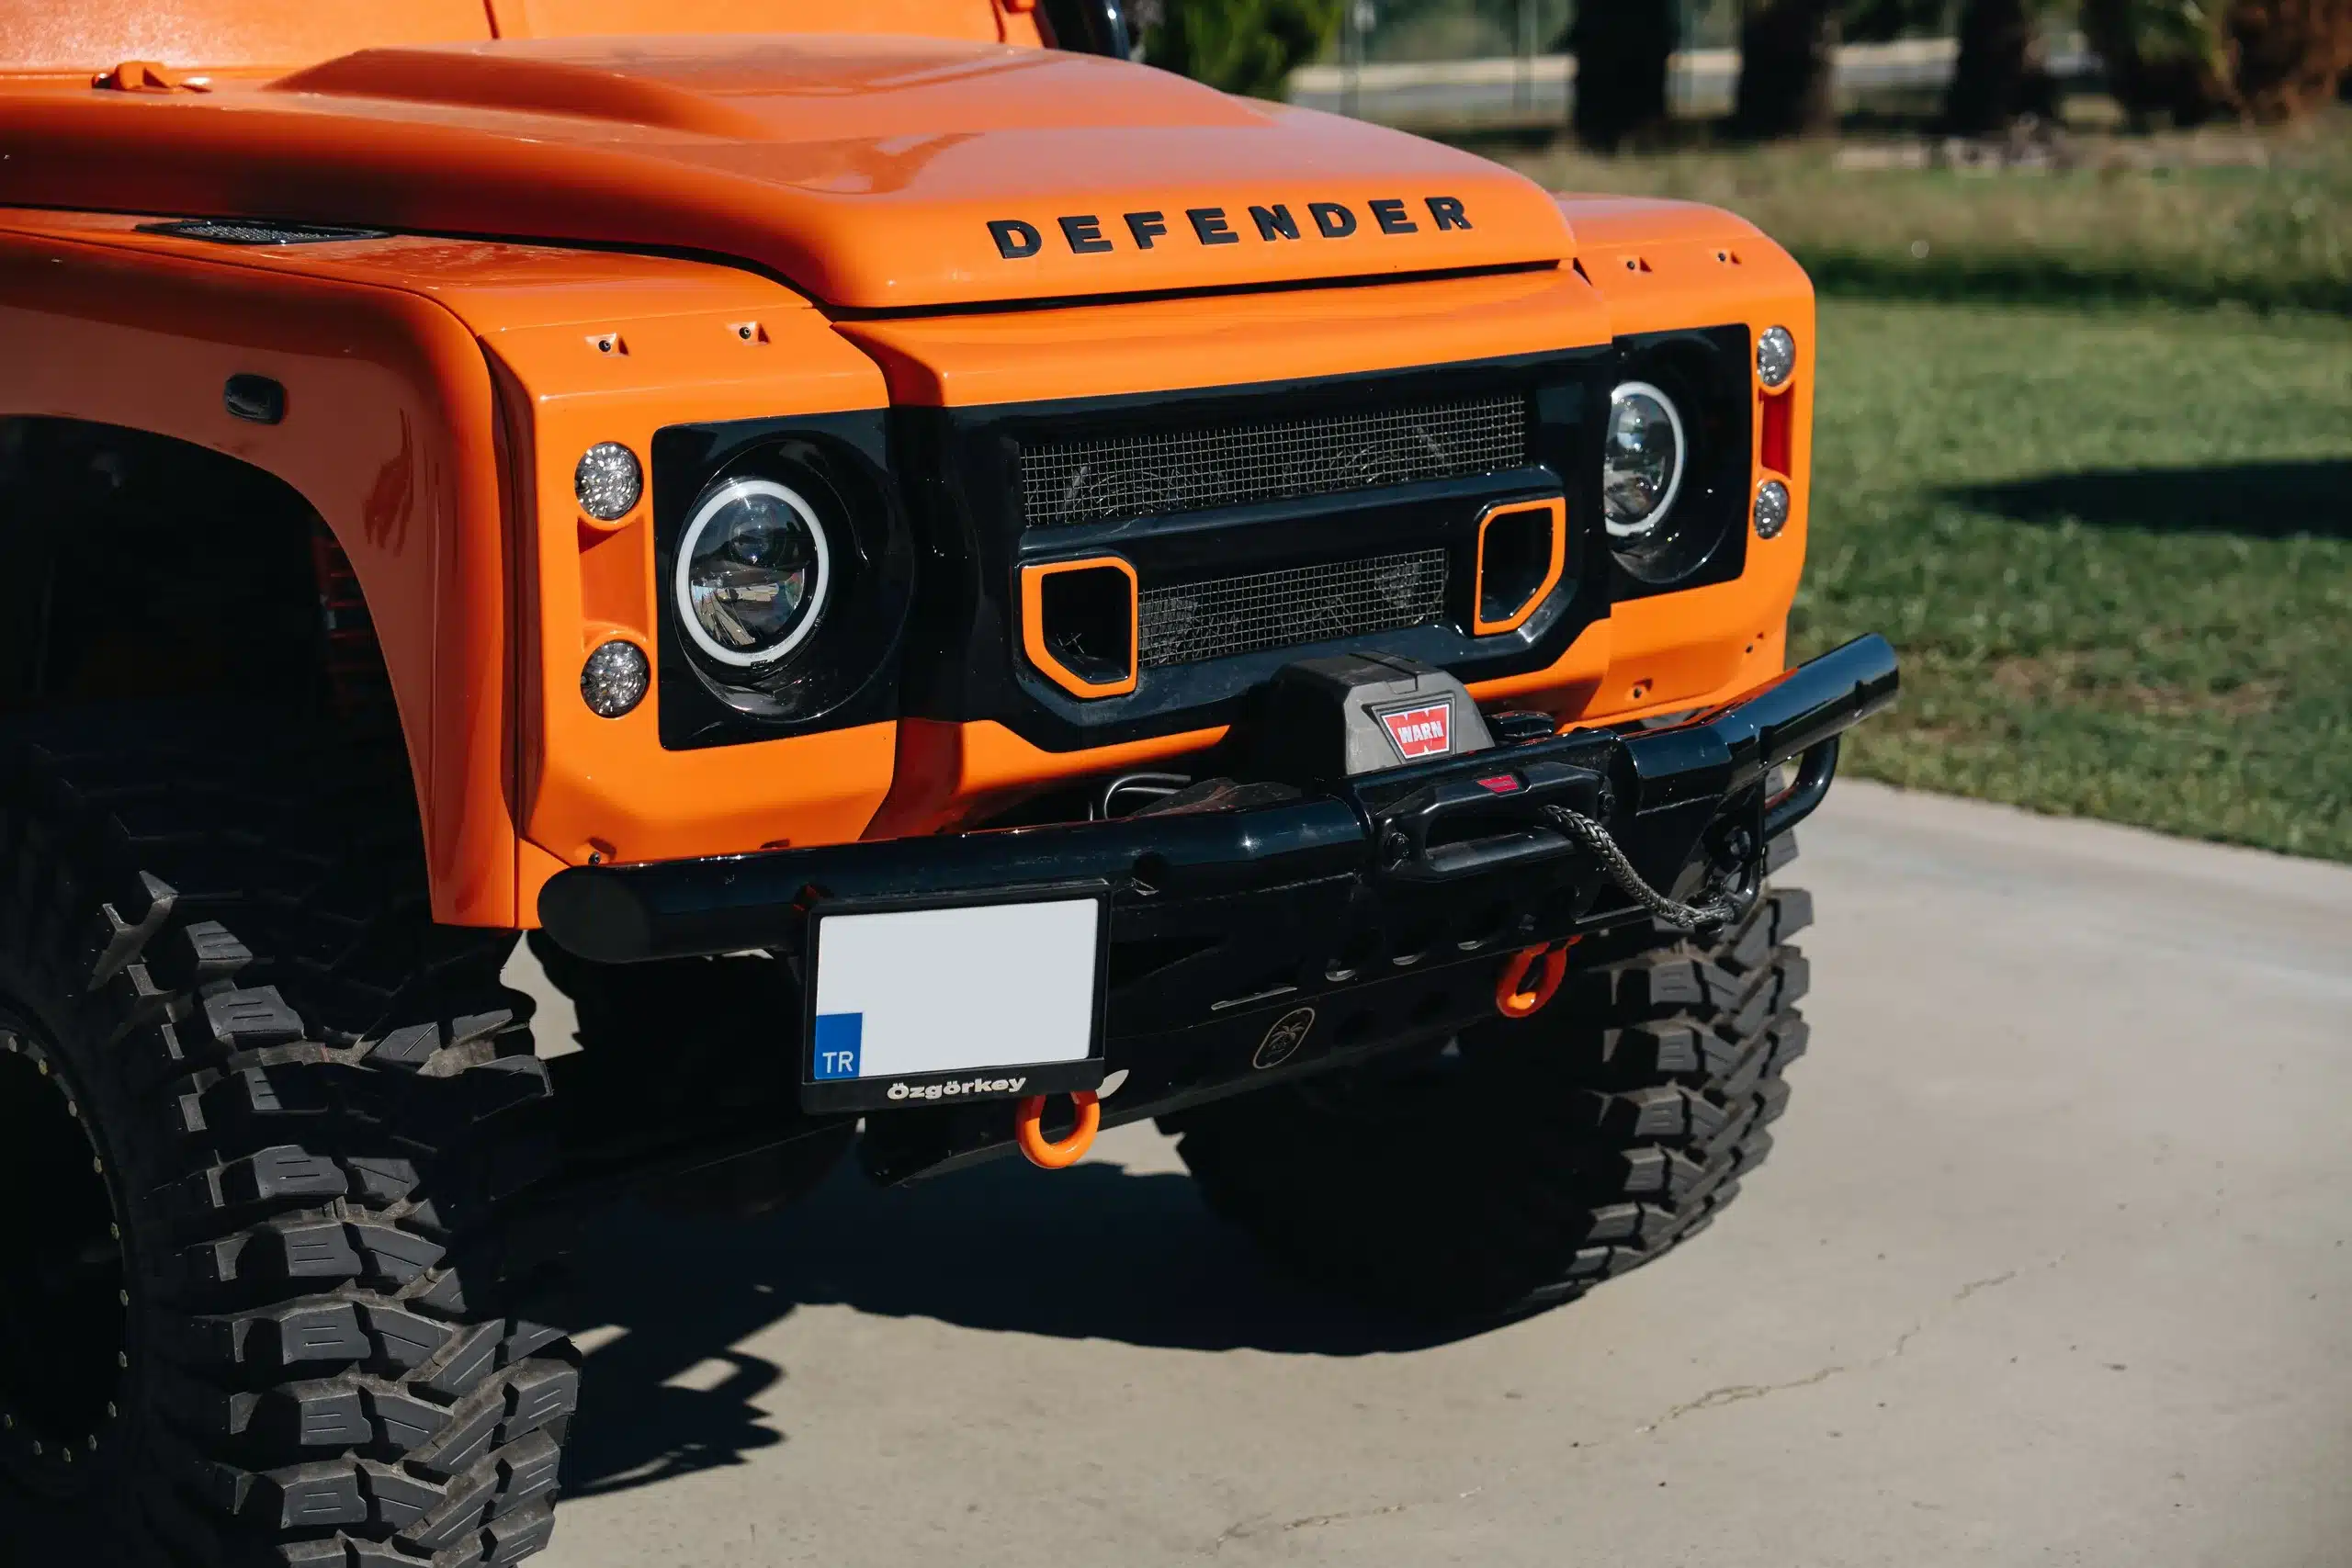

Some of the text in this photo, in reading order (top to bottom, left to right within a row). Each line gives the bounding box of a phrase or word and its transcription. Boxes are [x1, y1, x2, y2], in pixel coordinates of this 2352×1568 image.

[987, 196, 1473, 259] DEFENDER
[1396, 720, 1445, 744] WARN
[822, 1050, 854, 1074] TR
[887, 1076, 1027, 1100] Özgörkey
